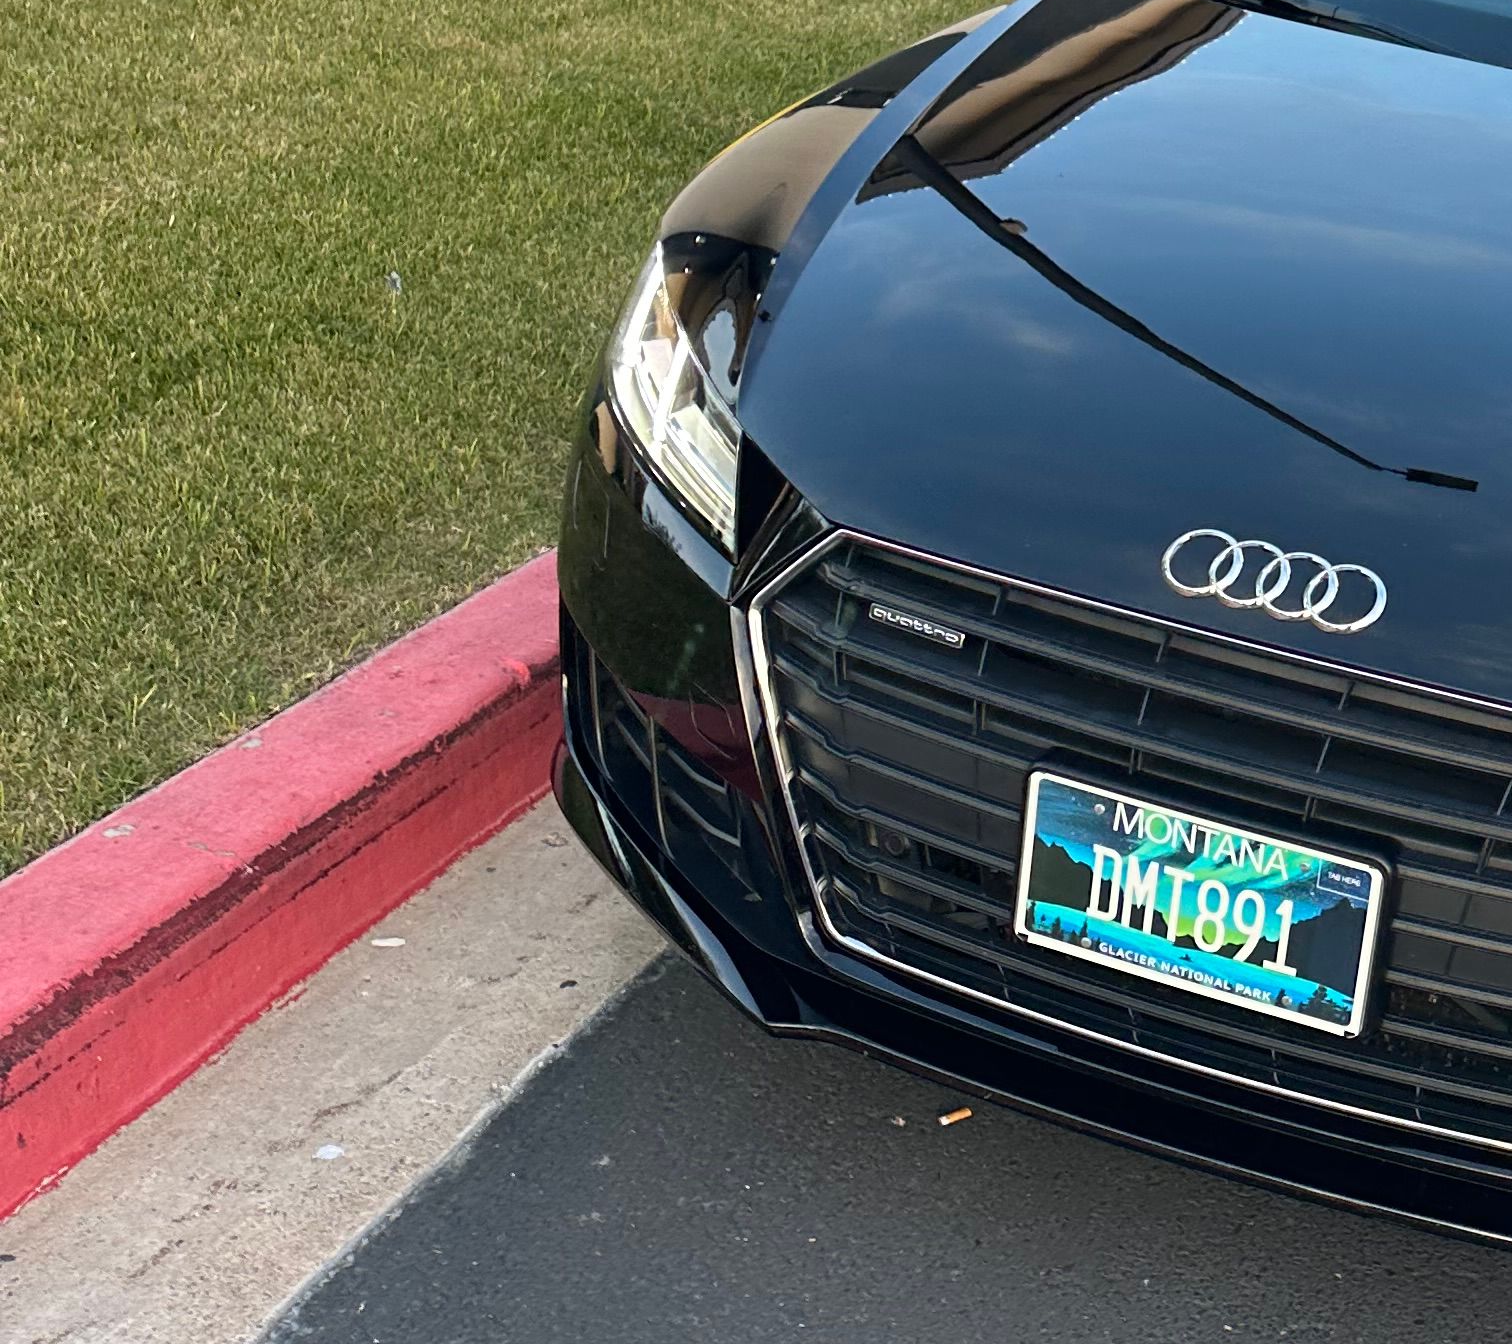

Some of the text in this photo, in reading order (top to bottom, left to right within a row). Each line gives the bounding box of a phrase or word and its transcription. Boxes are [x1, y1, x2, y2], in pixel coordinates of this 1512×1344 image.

[874, 607, 959, 643] quattro
[1112, 802, 1288, 881] MONTANA
[1086, 843, 1297, 977] DMT891
[1099, 942, 1271, 1002] GLACIER NATIONAL PARK
